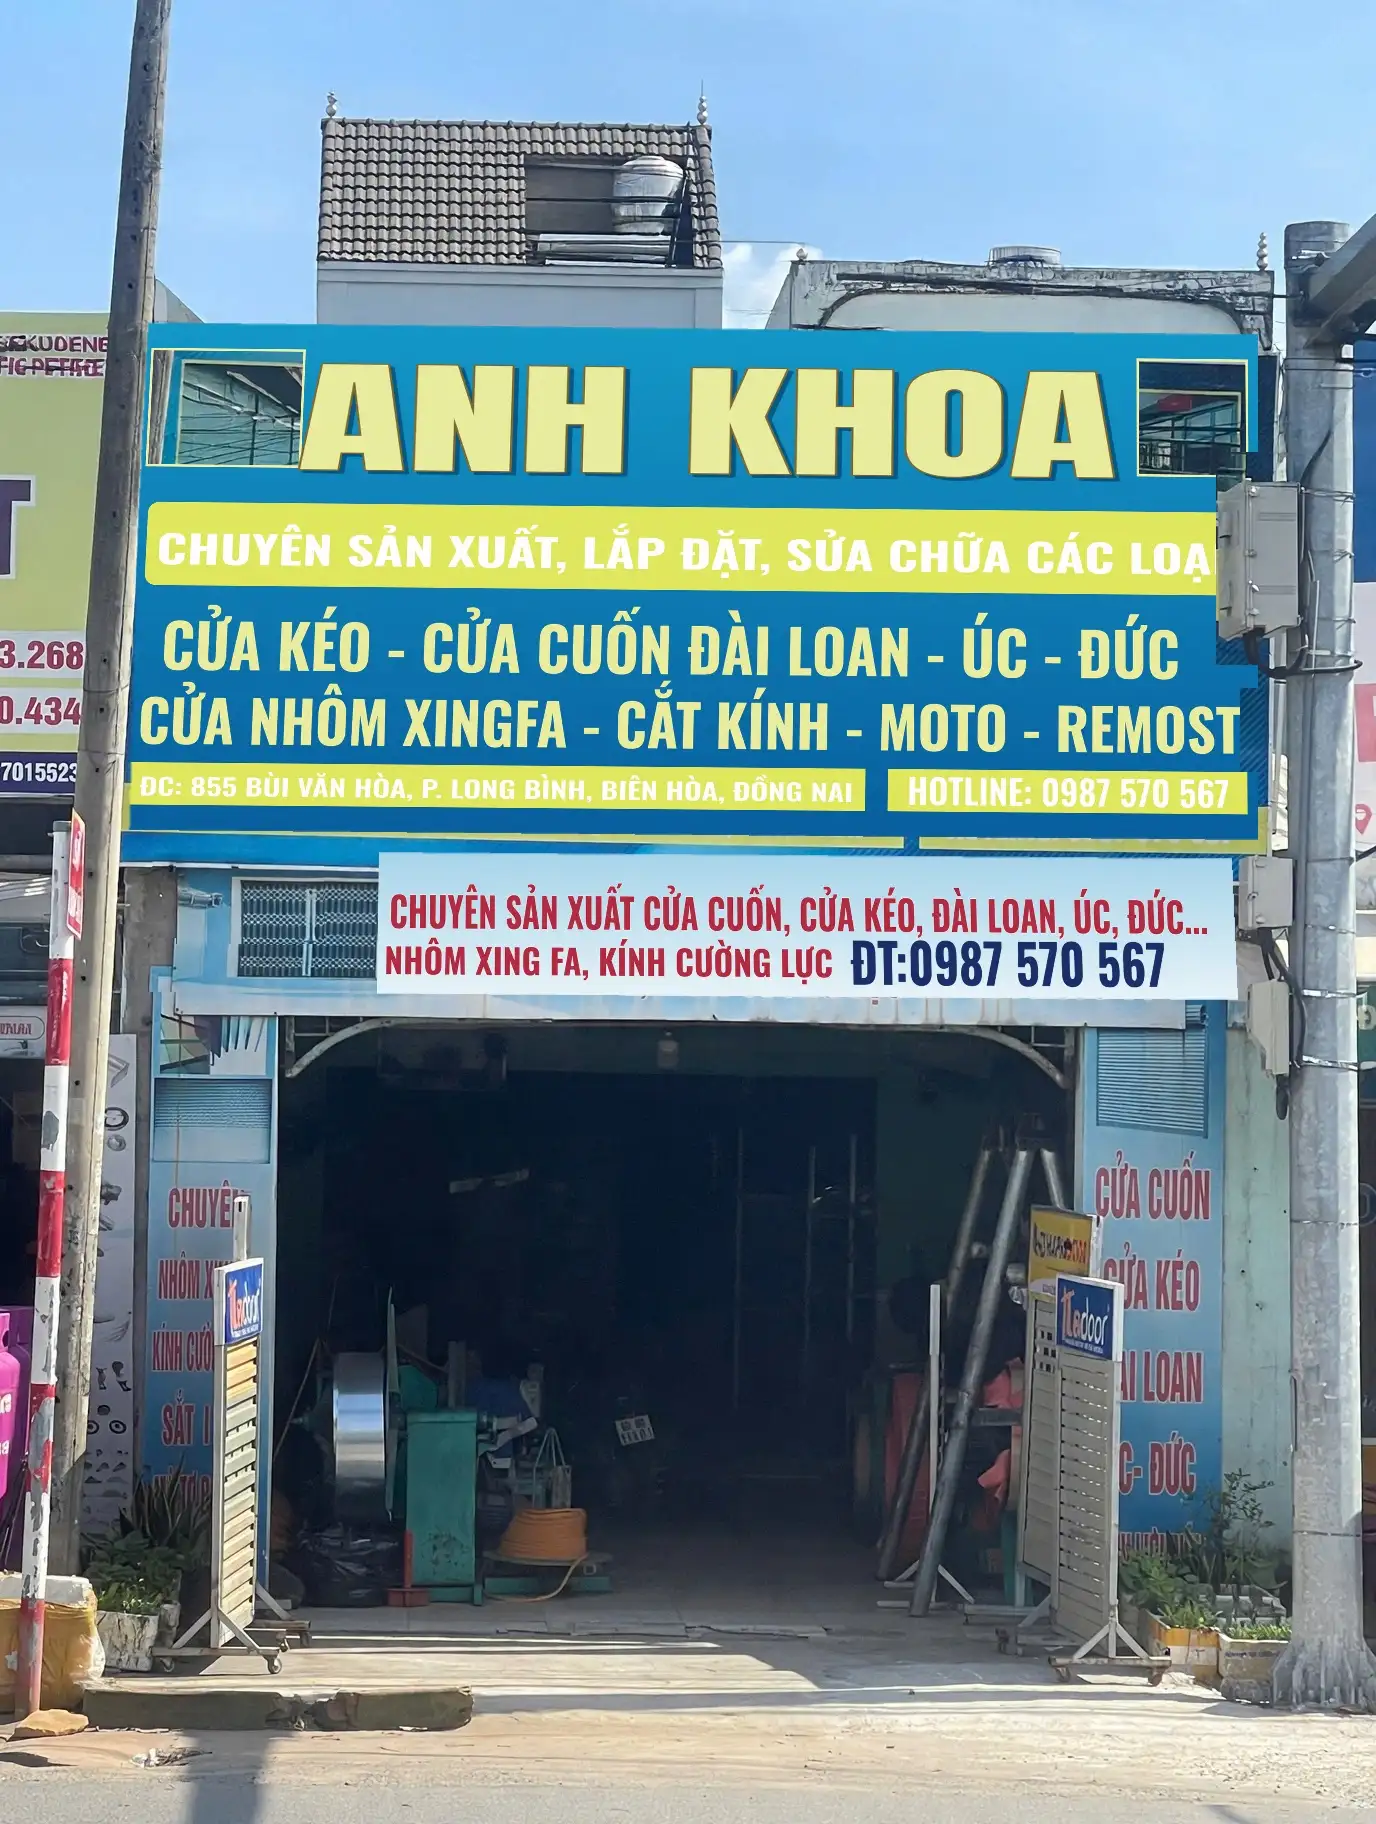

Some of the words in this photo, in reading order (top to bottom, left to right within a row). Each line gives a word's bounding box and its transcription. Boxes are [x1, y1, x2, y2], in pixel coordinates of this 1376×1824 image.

[298, 363, 627, 474] ANH
[688, 366, 1116, 480] KHOA
[158, 523, 331, 567] CHUYÊN
[348, 524, 432, 568] SẢN
[448, 524, 566, 574] XUẤT,
[584, 523, 665, 570] LẮP
[680, 529, 770, 579] ĐẶT,
[787, 528, 873, 572] SỬA
[889, 531, 1010, 574] CHỮA
[1027, 531, 1113, 575] CÁC
[1131, 541, 1212, 583] LOẠ
[0, 640, 84, 670] 3.268
[163, 604, 260, 671] CỬA
[279, 605, 370, 673] KÉO
[388, 650, 405, 658] -
[423, 605, 520, 674] CỬA
[538, 606, 670, 675] CUỐN
[687, 607, 769, 676] ĐÀI
[789, 625, 909, 677] LOAN
[927, 655, 944, 663] -
[963, 611, 1027, 679] ÚC
[1045, 656, 1061, 664] -
[1077, 613, 1178, 680] ĐỨC
[0, 695, 81, 725] 0.434
[140, 680, 233, 746] CỬA
[251, 682, 386, 747] NHÔM
[403, 698, 566, 748] XINGFA
[583, 727, 599, 735] -
[617, 681, 701, 749] CẮT
[717, 686, 828, 751] KÍNH
[847, 729, 862, 737] -
[880, 702, 1006, 753] MOTO
[1023, 731, 1039, 739] -
[1058, 704, 1241, 755] REMOST
[140, 776, 181, 797] ĐC:
[191, 776, 237, 797] 855
[245, 771, 289, 798] BÙI
[298, 773, 345, 798] VĂN
[355, 772, 413, 801] HÒA,
[422, 778, 442, 799] P.
[451, 779, 515, 799] LONG
[525, 773, 592, 803] BÌNH,
[601, 775, 657, 801] BIÊN
[666, 775, 725, 804] HÒA,
[733, 776, 802, 802] ĐỒNG
[811, 782, 852, 803] NAI
[908, 776, 1031, 807] HOTLINE:
[1042, 777, 1110, 808] 0987
[1120, 778, 1169, 809] 570
[1180, 778, 1229, 809] 567
[391, 885, 495, 929] CHUYÊN
[507, 884, 556, 930] SẢN
[568, 884, 634, 930] XUẤT
[644, 886, 698, 930] CỬA
[709, 885, 790, 935] CUỐN,
[800, 887, 854, 931] CỬA
[865, 888, 922, 936] KÉO,
[933, 888, 977, 932] ĐÀI
[989, 899, 1064, 938] LOAN,
[1075, 889, 1118, 937] ÚC,
[1128, 889, 1207, 934] ĐỨC...
[386, 939, 465, 975] NHÔM
[477, 947, 540, 975] XING
[552, 948, 588, 979] FA,
[600, 939, 664, 976] KÍNH
[676, 941, 770, 977] CƯỜNG
[782, 946, 832, 984] LỰC
[851, 941, 1001, 986] ĐT:0987
[1018, 942, 1083, 987] 570
[1099, 942, 1164, 987] 567
[1096, 1150, 1140, 1218] CỬA
[1148, 1151, 1210, 1220] CUỐN
[158, 1251, 200, 1299] NHÔM
[1156, 1249, 1200, 1311] KÉO
[153, 1323, 183, 1371] KÍNH
[1144, 1351, 1202, 1402] LOAN
[163, 1389, 195, 1446] SẮT
[1149, 1431, 1196, 1495] ĐỨC
